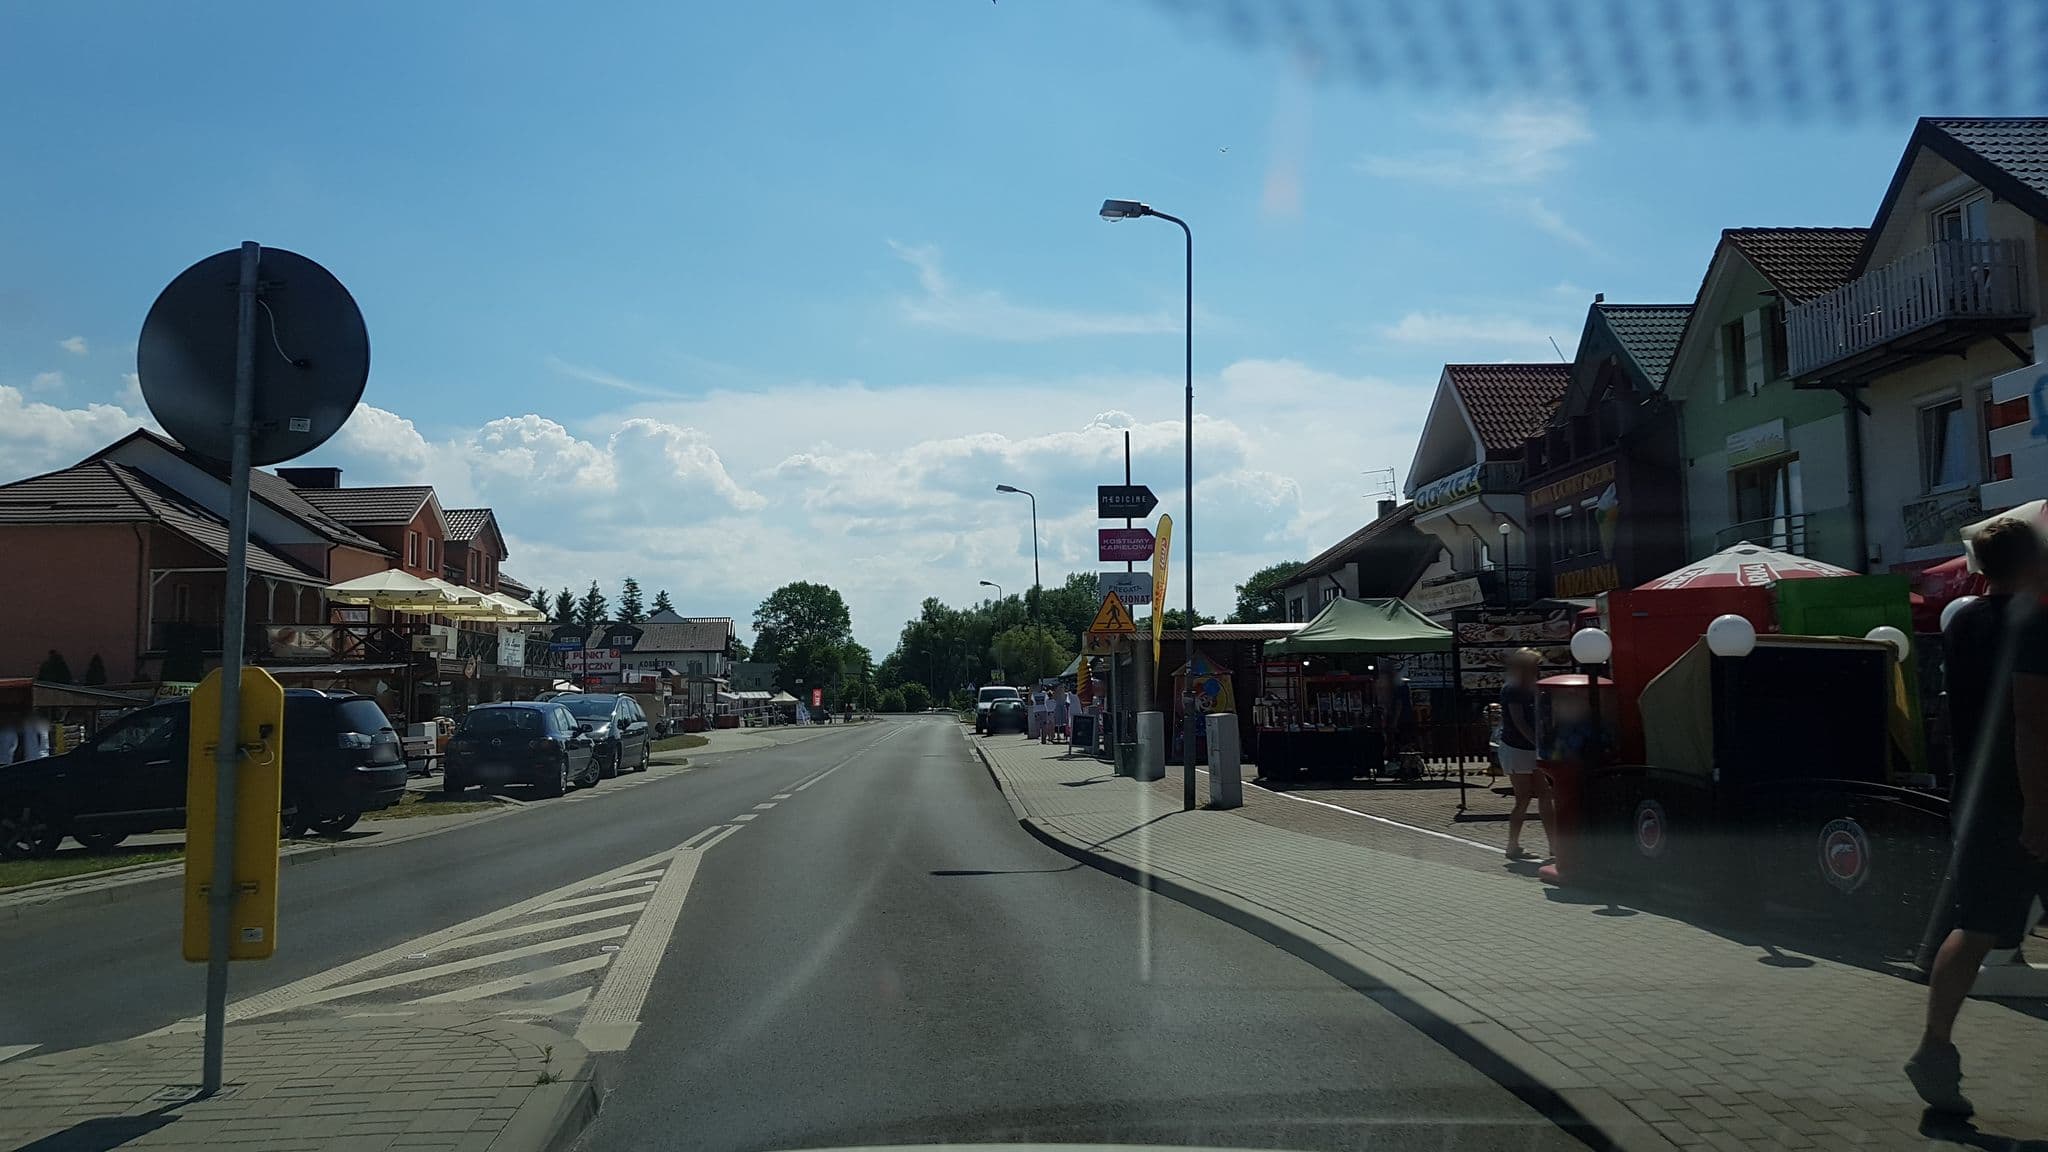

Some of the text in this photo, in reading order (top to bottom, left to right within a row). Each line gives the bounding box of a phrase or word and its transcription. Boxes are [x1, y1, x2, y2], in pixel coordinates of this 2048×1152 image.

[1102, 495, 1147, 504] MEDICINE
[1103, 595, 1150, 604] SJONAT
[573, 651, 605, 660] PUNKT
[566, 662, 613, 671] APTCZNY
